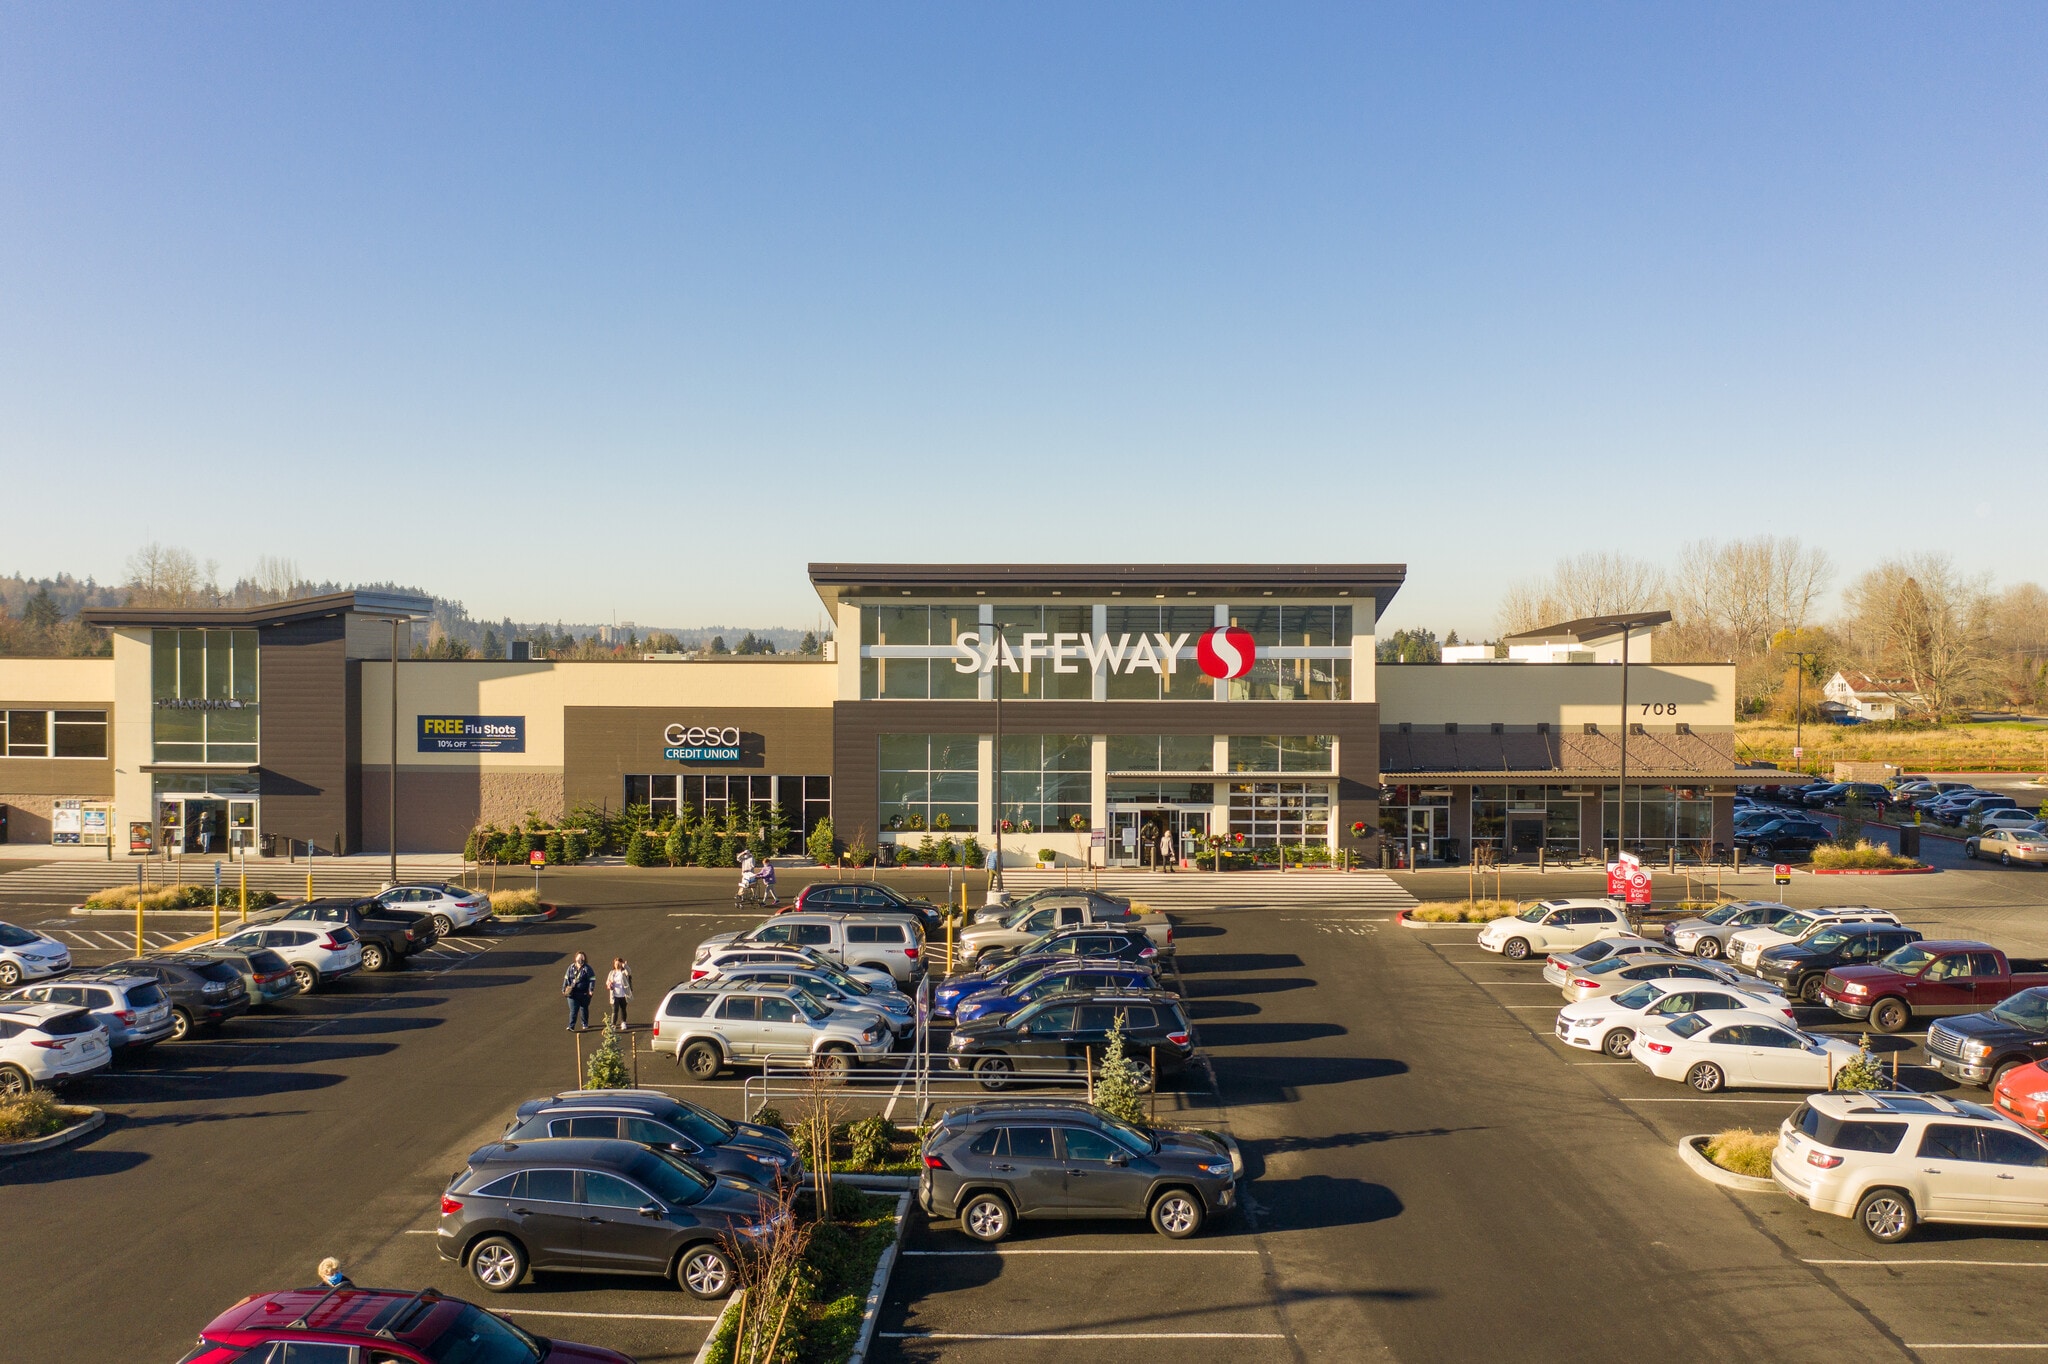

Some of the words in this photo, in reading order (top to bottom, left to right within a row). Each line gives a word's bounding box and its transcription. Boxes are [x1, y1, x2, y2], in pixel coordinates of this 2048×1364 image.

[955, 632, 1191, 675] SAFEWAY
[158, 698, 249, 711] PHARMACY
[1641, 702, 1677, 716] 708
[424, 719, 464, 734] FREE
[465, 724, 482, 734] Flu
[484, 724, 517, 734] Shots
[664, 723, 740, 746] Gesa
[437, 740, 454, 748] 10%
[665, 748, 702, 759] CREDIT
[703, 749, 738, 759] UNION
